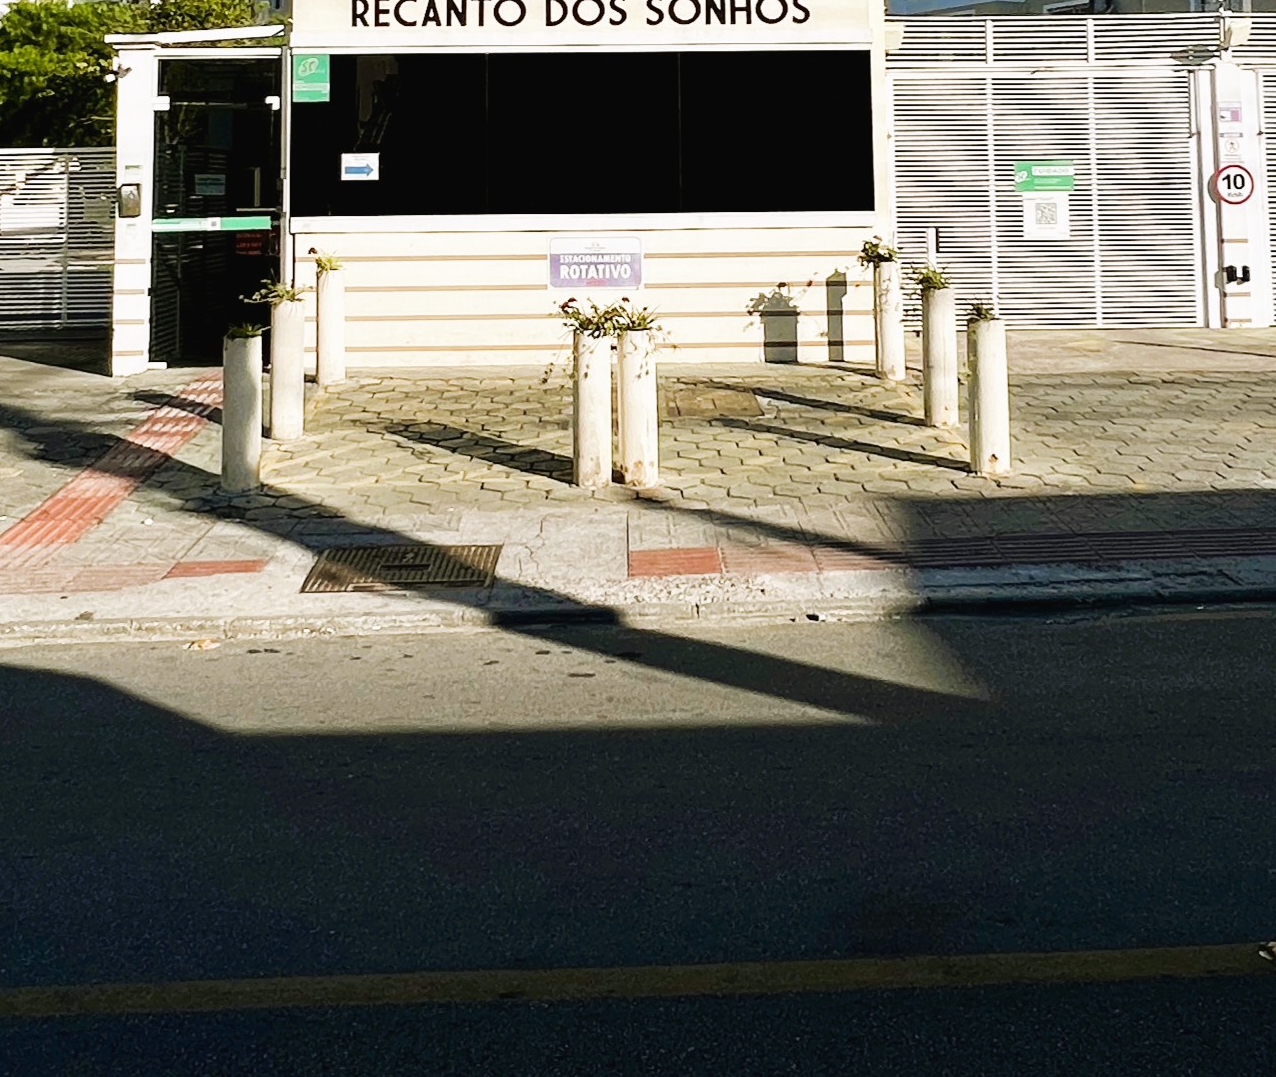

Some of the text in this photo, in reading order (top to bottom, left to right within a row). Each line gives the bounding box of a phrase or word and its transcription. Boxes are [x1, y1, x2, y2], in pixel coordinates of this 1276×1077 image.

[1222, 173, 1246, 190] 10
[559, 254, 632, 263] ESTACIONAMENTO
[559, 264, 632, 279] ROTATIVO
